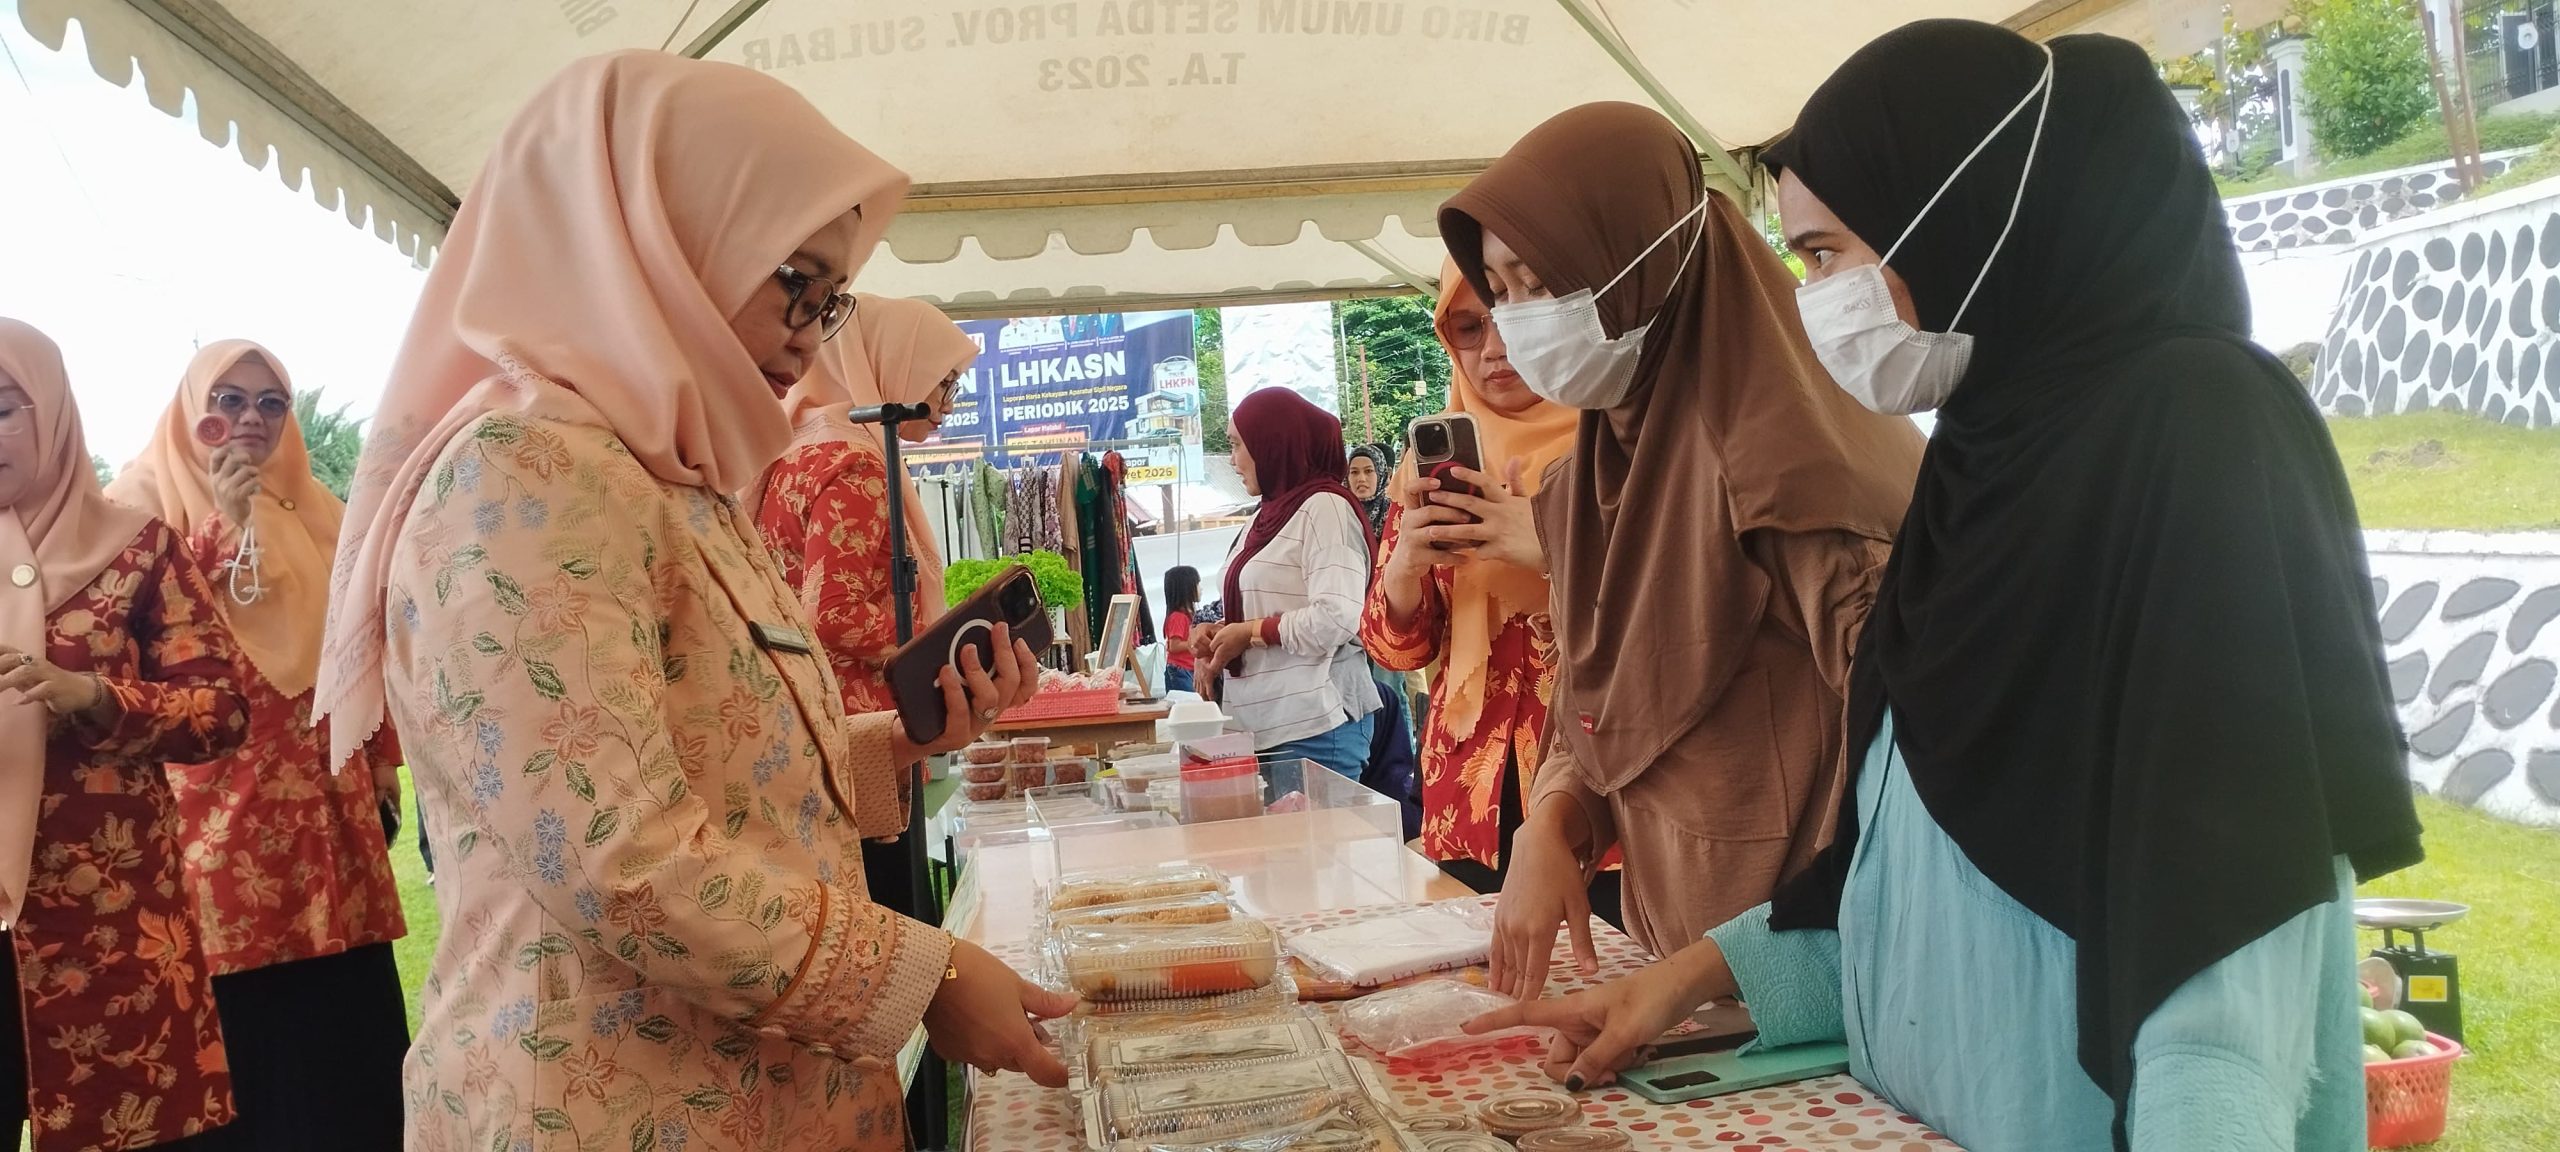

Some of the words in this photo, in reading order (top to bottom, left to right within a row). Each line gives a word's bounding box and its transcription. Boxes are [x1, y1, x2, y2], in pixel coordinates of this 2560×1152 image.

[1001, 350, 1126, 389] LHKASN
[1159, 377, 1195, 389] LHKPN
[1003, 399, 1085, 421] PERIODIK
[1088, 395, 1130, 413] 2025
[945, 411, 980, 428] 2025
[1144, 467, 1173, 478] 2026
